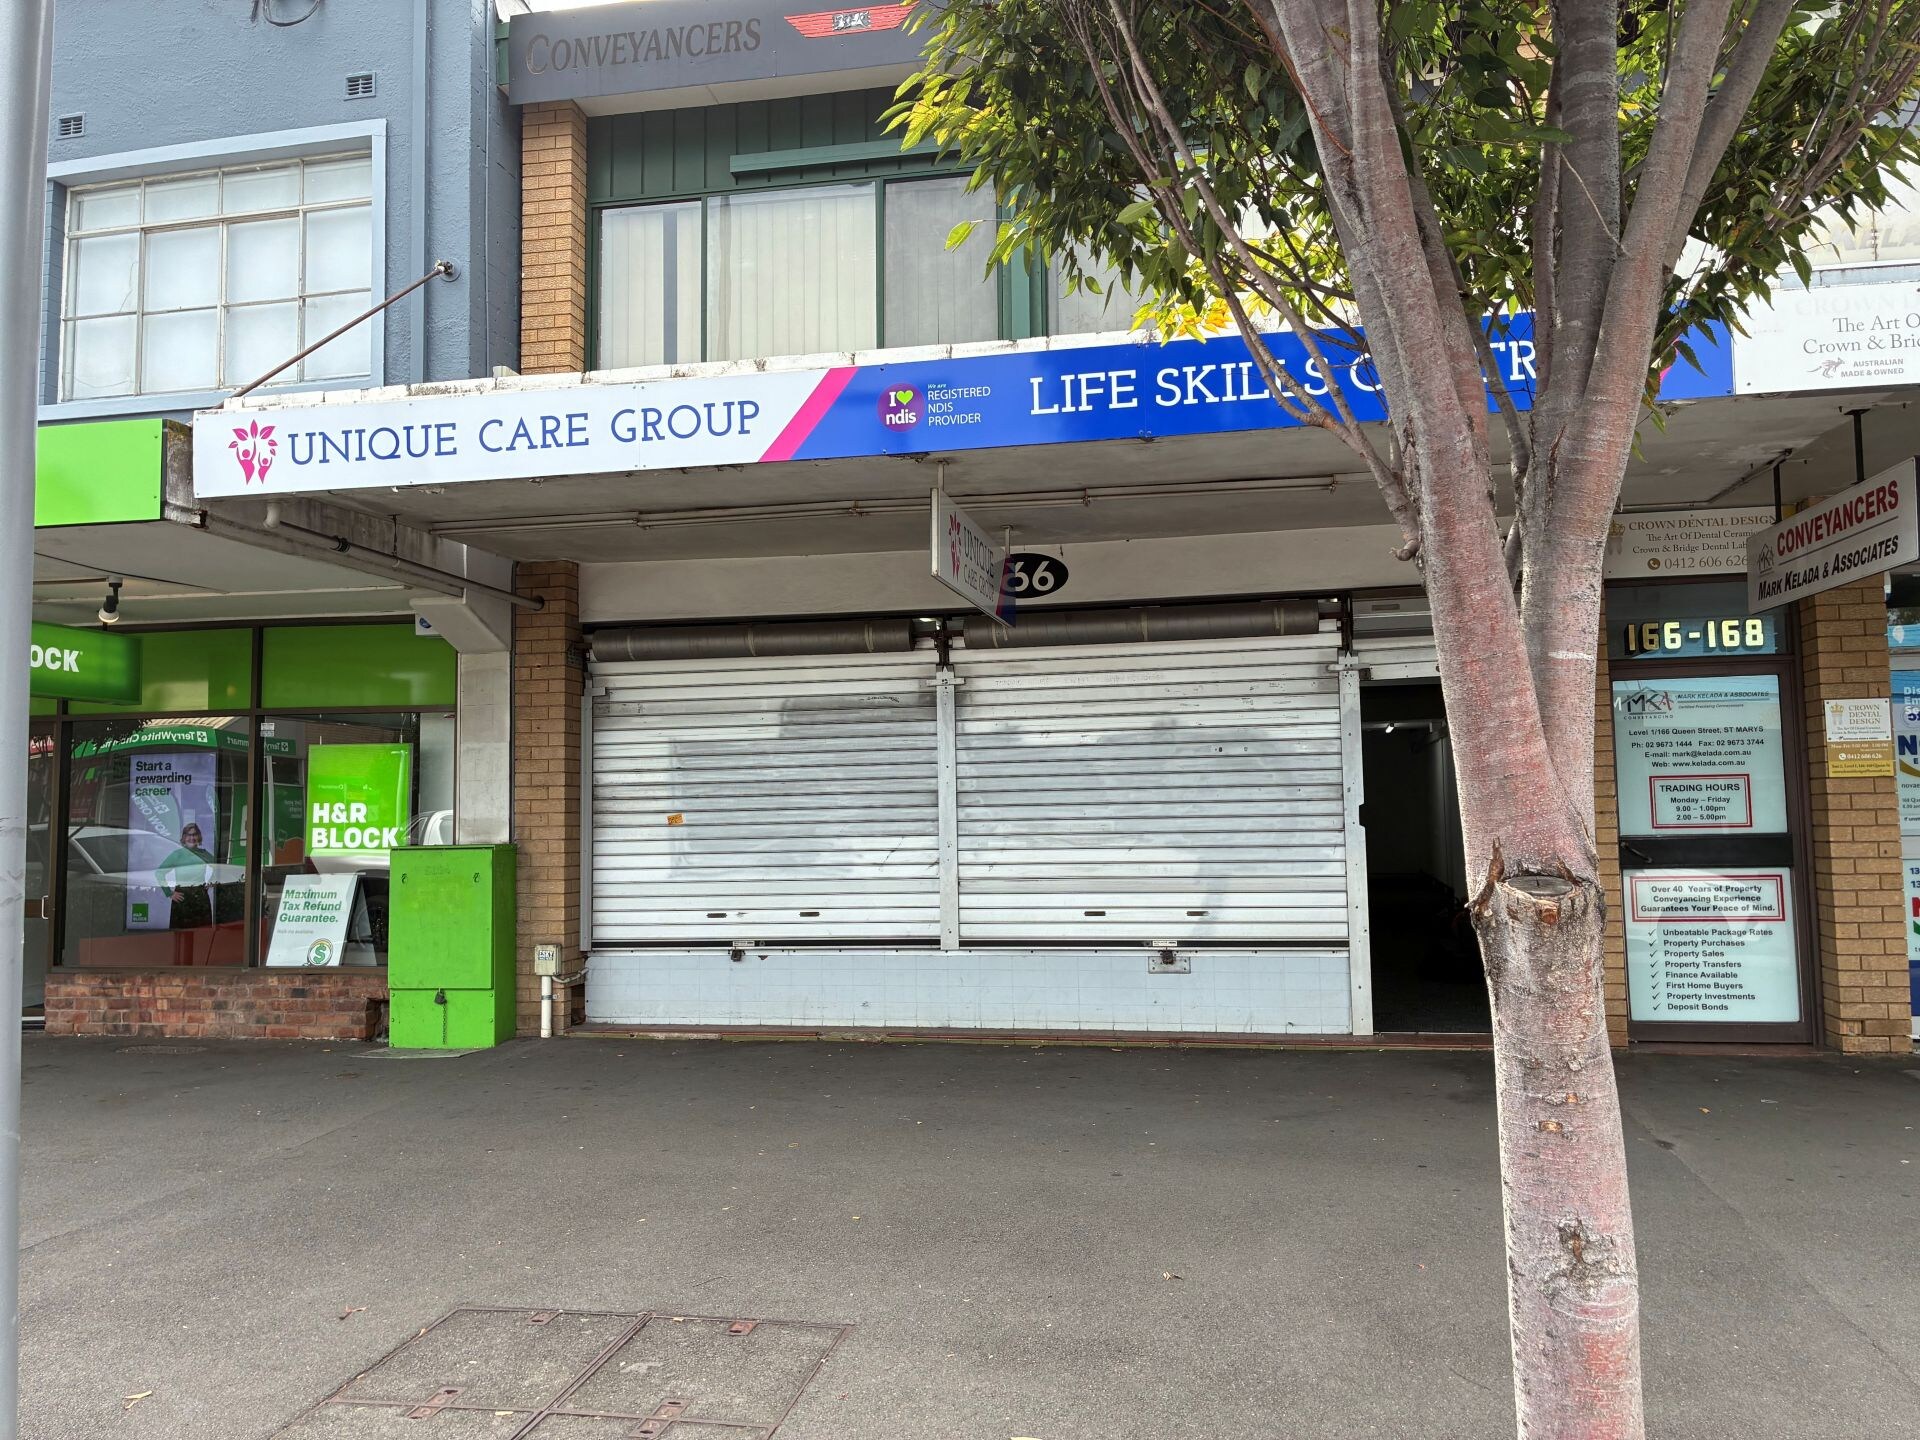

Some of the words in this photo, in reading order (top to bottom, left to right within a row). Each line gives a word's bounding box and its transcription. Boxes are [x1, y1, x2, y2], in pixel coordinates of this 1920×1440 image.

[526, 18, 762, 75] CONVEYANCERS
[1833, 317, 1865, 333] The
[1870, 315, 1900, 330] Art
[1905, 313, 1920, 329] O
[1803, 338, 1861, 354] Crown
[1867, 335, 1886, 350] &
[1853, 358, 1904, 368] AUSTRALIAN
[1841, 370, 1865, 378] MADE
[1873, 368, 1904, 377] OWNED
[1030, 369, 1139, 415] LIFE
[1155, 357, 1329, 406] SKILLS
[928, 386, 991, 400] REGISTERED
[889, 391, 897, 407] I
[928, 402, 953, 413] NDIS
[886, 409, 916, 425] ndis
[928, 413, 981, 426] PROVIDER
[288, 422, 457, 465] UNIQUE
[479, 412, 590, 452] CARE
[611, 400, 760, 443] GROUP
[1777, 480, 1899, 557] CONVEYANCERS
[1629, 519, 1675, 531] CROWN
[1678, 518, 1728, 529] DENTAL
[1646, 533, 1662, 541] The
[1664, 533, 1677, 541] Art
[1680, 531, 1693, 540] Of
[1694, 530, 1721, 539] Dental
[963, 526, 994, 579] UNIQUE
[1633, 546, 1659, 554] Crown
[1662, 545, 1671, 553] &
[1673, 543, 1699, 553] Bridge
[1702, 543, 1729, 551] Dental
[1664, 558, 1694, 570] 0412
[1700, 556, 1721, 567] 606
[1726, 554, 1747, 566] 626
[1758, 578, 1782, 600] MARK
[1784, 566, 1819, 591] KELADA
[1822, 561, 1829, 578] &
[1832, 535, 1899, 575] ASSOCIATES
[1628, 619, 1764, 651] 166-168
[31, 645, 80, 672] OCK
[1697, 691, 1722, 699] KELADA
[1730, 690, 1769, 698] ASSOCIATES
[1651, 728, 1669, 736] 1/166
[1671, 728, 1696, 736] Queen
[1697, 727, 1722, 735] Street,
[1672, 750, 1751, 758] mark@kelada.com.au
[136, 760, 163, 771] Start
[165, 762, 172, 770] a
[135, 772, 192, 785] rewarding
[135, 787, 171, 796] career
[1659, 784, 1703, 792] TRADING
[1705, 783, 1740, 791] HOURS
[1707, 796, 1730, 804] Friday
[313, 802, 367, 823] H&R
[1700, 805, 1726, 813] 1.00pm
[1700, 813, 1726, 821] 5.00pm
[312, 827, 399, 848] BLOCK
[284, 889, 337, 899] Maximum
[1651, 885, 1671, 893] Over
[1673, 885, 1683, 893] 40
[1688, 885, 1712, 893] Years
[1725, 885, 1762, 893] Property
[1653, 895, 1711, 903] Conveyancing
[1713, 895, 1761, 903] Experience
[283, 901, 300, 911] Tax
[303, 901, 342, 911] Refund
[1691, 904, 1710, 912] Your
[1712, 904, 1739, 912] Peace
[1741, 904, 1750, 912] of
[1752, 904, 1776, 912] Mind.
[280, 913, 339, 923] Guarantee.
[1663, 928, 1709, 936] Unbeatable
[1711, 928, 1747, 937] Package
[1749, 928, 1773, 936] Rates
[1663, 940, 1699, 948] Property
[1701, 939, 1745, 947] Purchases
[1664, 950, 1699, 958] Property
[1665, 961, 1700, 969] Property
[1703, 960, 1742, 968] Transfers
[1713, 982, 1743, 990] Buyers
[1667, 993, 1702, 1001] Property
[1667, 1003, 1699, 1011] Deposit
[1701, 1003, 1729, 1011] Bonds
